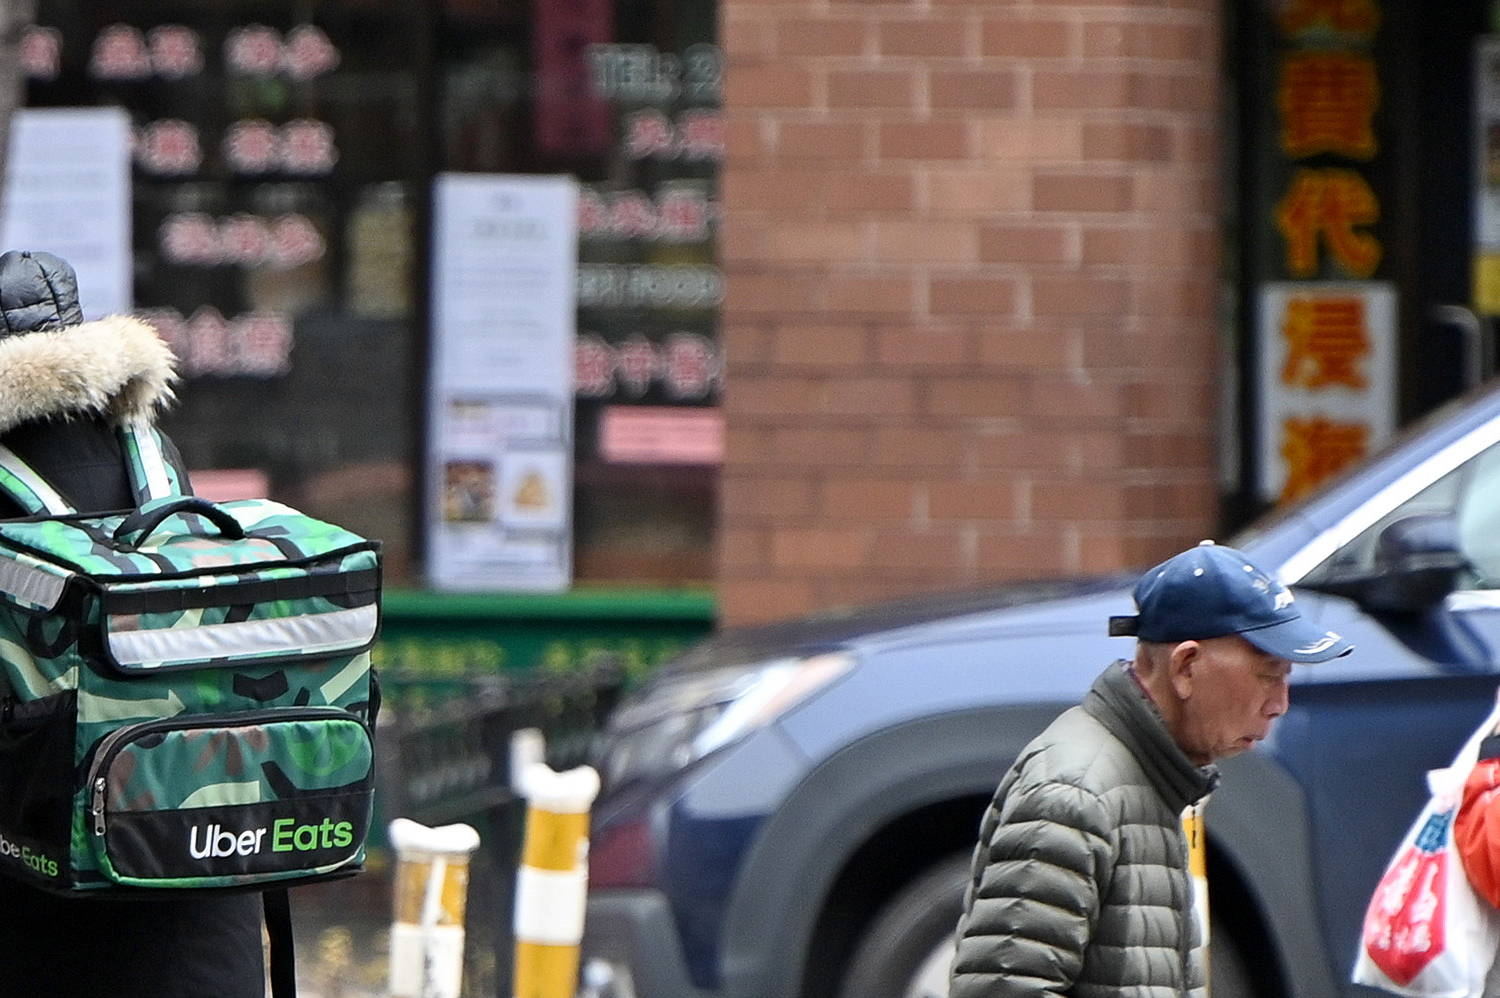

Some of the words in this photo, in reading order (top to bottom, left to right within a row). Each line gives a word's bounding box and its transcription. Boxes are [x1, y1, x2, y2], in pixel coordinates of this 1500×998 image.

[189, 824, 267, 860] Uber
[271, 817, 354, 853] Eats
[21, 845, 59, 877] Eats
